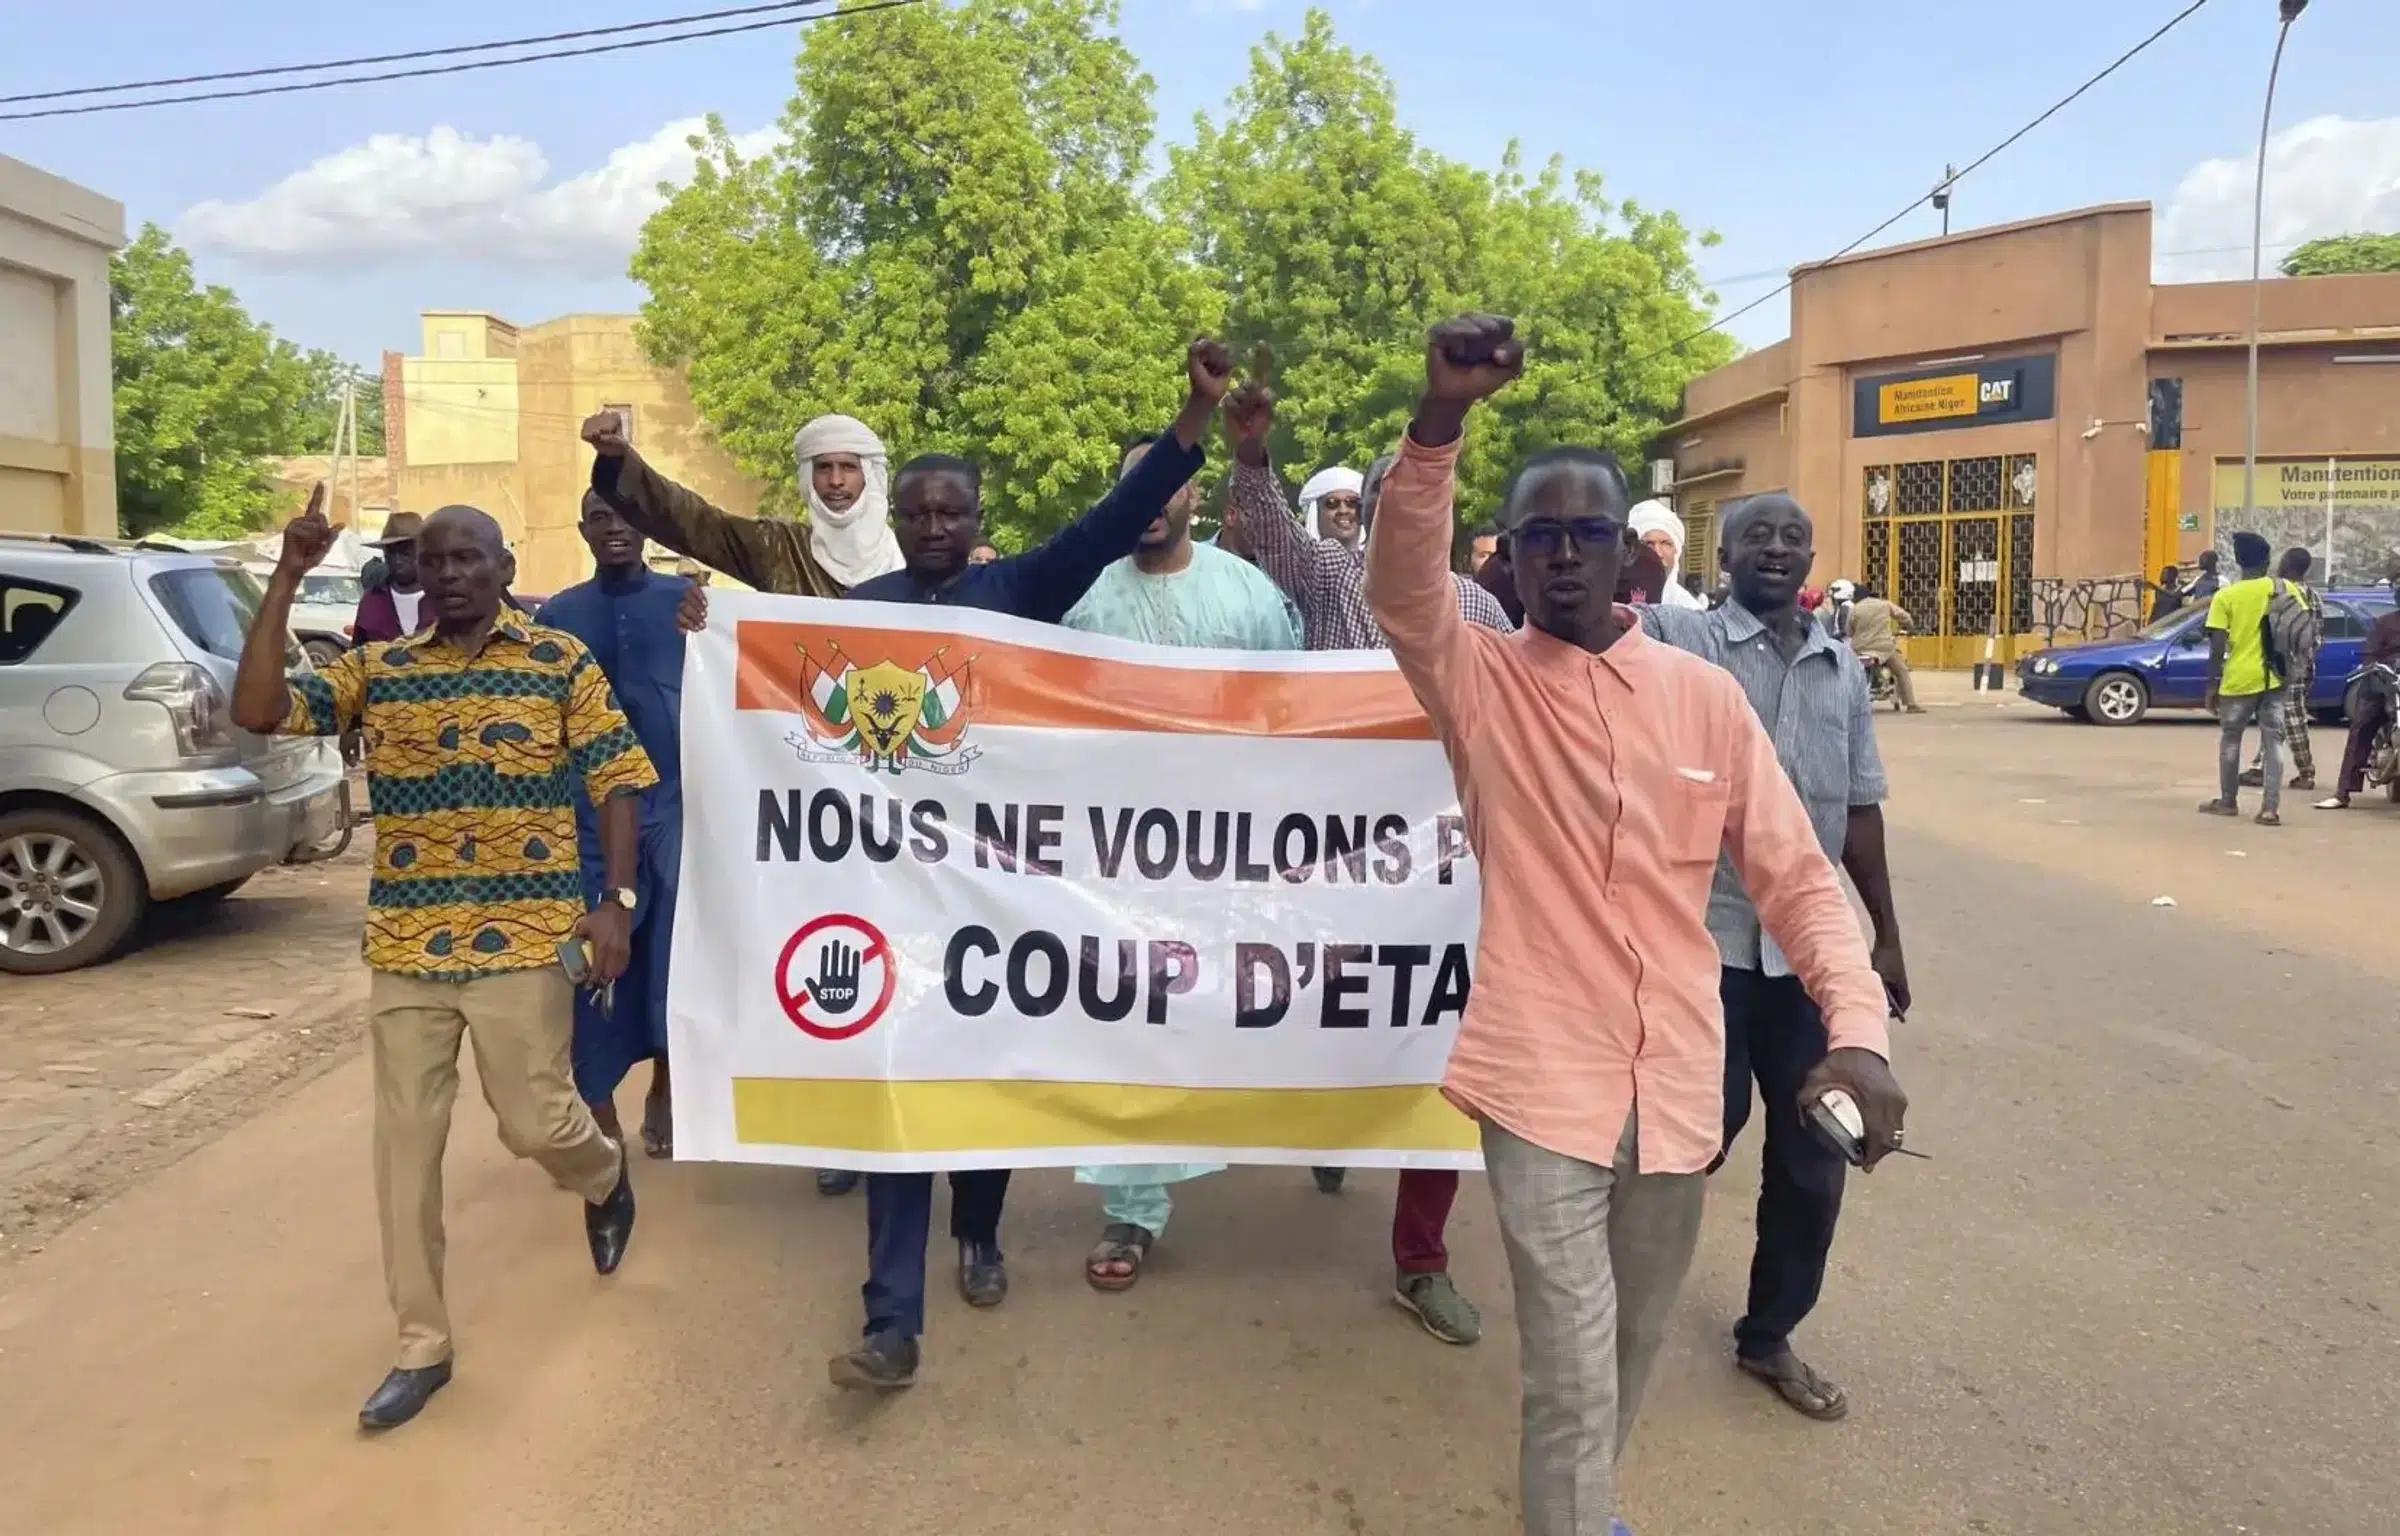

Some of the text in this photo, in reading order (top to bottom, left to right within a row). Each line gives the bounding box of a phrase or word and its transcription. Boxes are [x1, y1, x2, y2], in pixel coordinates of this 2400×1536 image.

[1980, 380, 2012, 402] CAT
[1938, 399, 1965, 412] Niger
[2281, 464, 2400, 482] Manutention
[2281, 488, 2316, 500] Votre
[2319, 487, 2388, 502] partenaire
[755, 787, 949, 864] NOUS
[973, 802, 1065, 877] NE
[1087, 805, 1413, 886] VOULONS
[943, 924, 1200, 1026] COUP
[819, 987, 855, 1001] STOP
